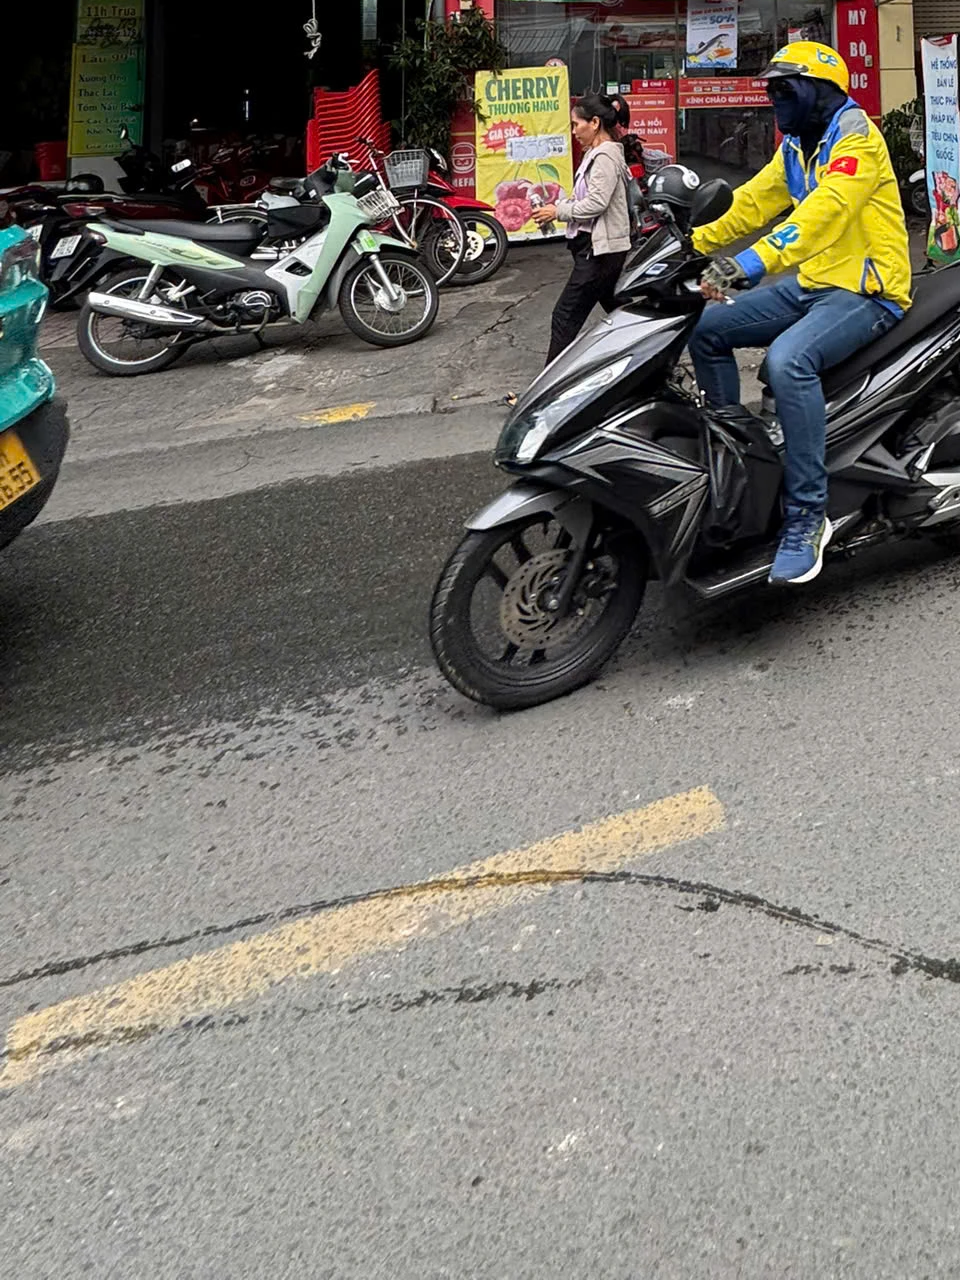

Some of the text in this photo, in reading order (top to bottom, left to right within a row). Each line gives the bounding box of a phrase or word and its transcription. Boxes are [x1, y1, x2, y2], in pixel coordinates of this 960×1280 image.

[848, 8, 866, 26] MỸ
[816, 48, 839, 67] be
[850, 40, 866, 58] BÒ
[851, 70, 868, 89] ÚC
[485, 76, 560, 102] CHERRY
[705, 95, 727, 104] CHÀO
[728, 95, 742, 103] QUÝ
[744, 94, 769, 103] KHÁCH
[633, 119, 646, 127] CÁ
